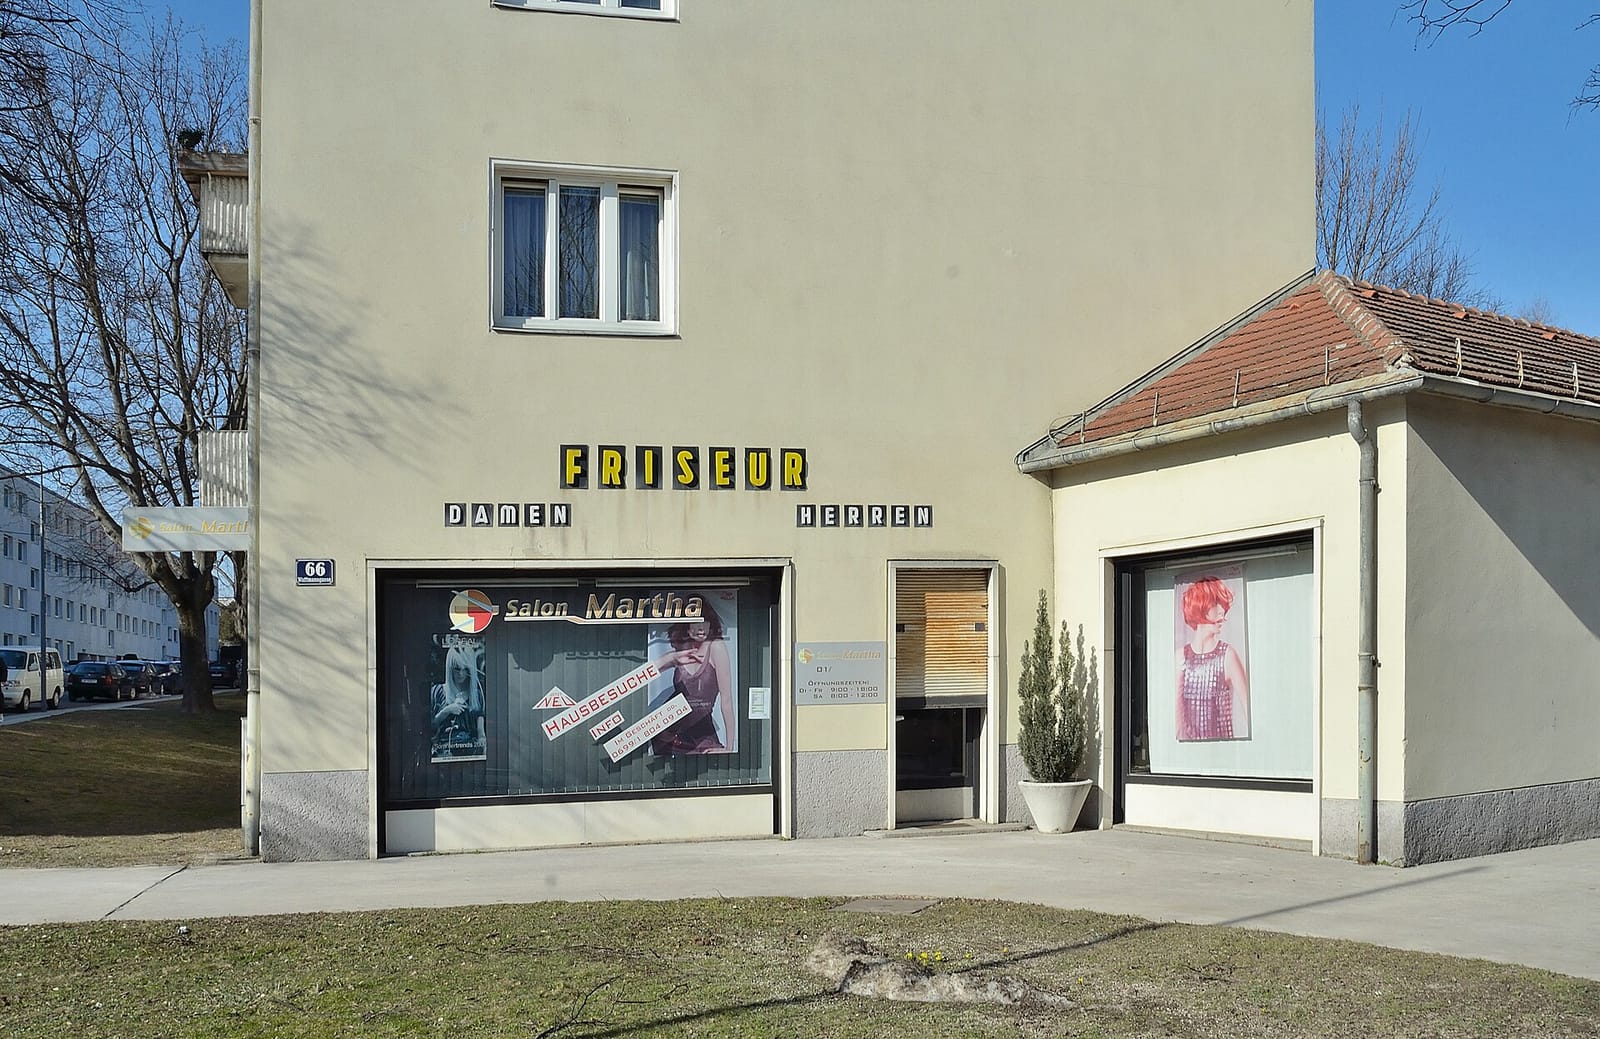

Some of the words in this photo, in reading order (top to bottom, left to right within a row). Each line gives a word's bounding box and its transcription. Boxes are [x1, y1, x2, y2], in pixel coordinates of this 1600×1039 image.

[564, 448, 804, 487] FRISEUR
[448, 504, 568, 525] DAMEN
[800, 506, 931, 526] HERREN
[305, 561, 326, 577] 66
[504, 599, 569, 617] Salon
[585, 592, 704, 619] Martha
[536, 696, 577, 708] NEU
[545, 664, 659, 737] HAUSBESUCHE
[676, 705, 689, 716] 04
[590, 713, 623, 739] INFO
